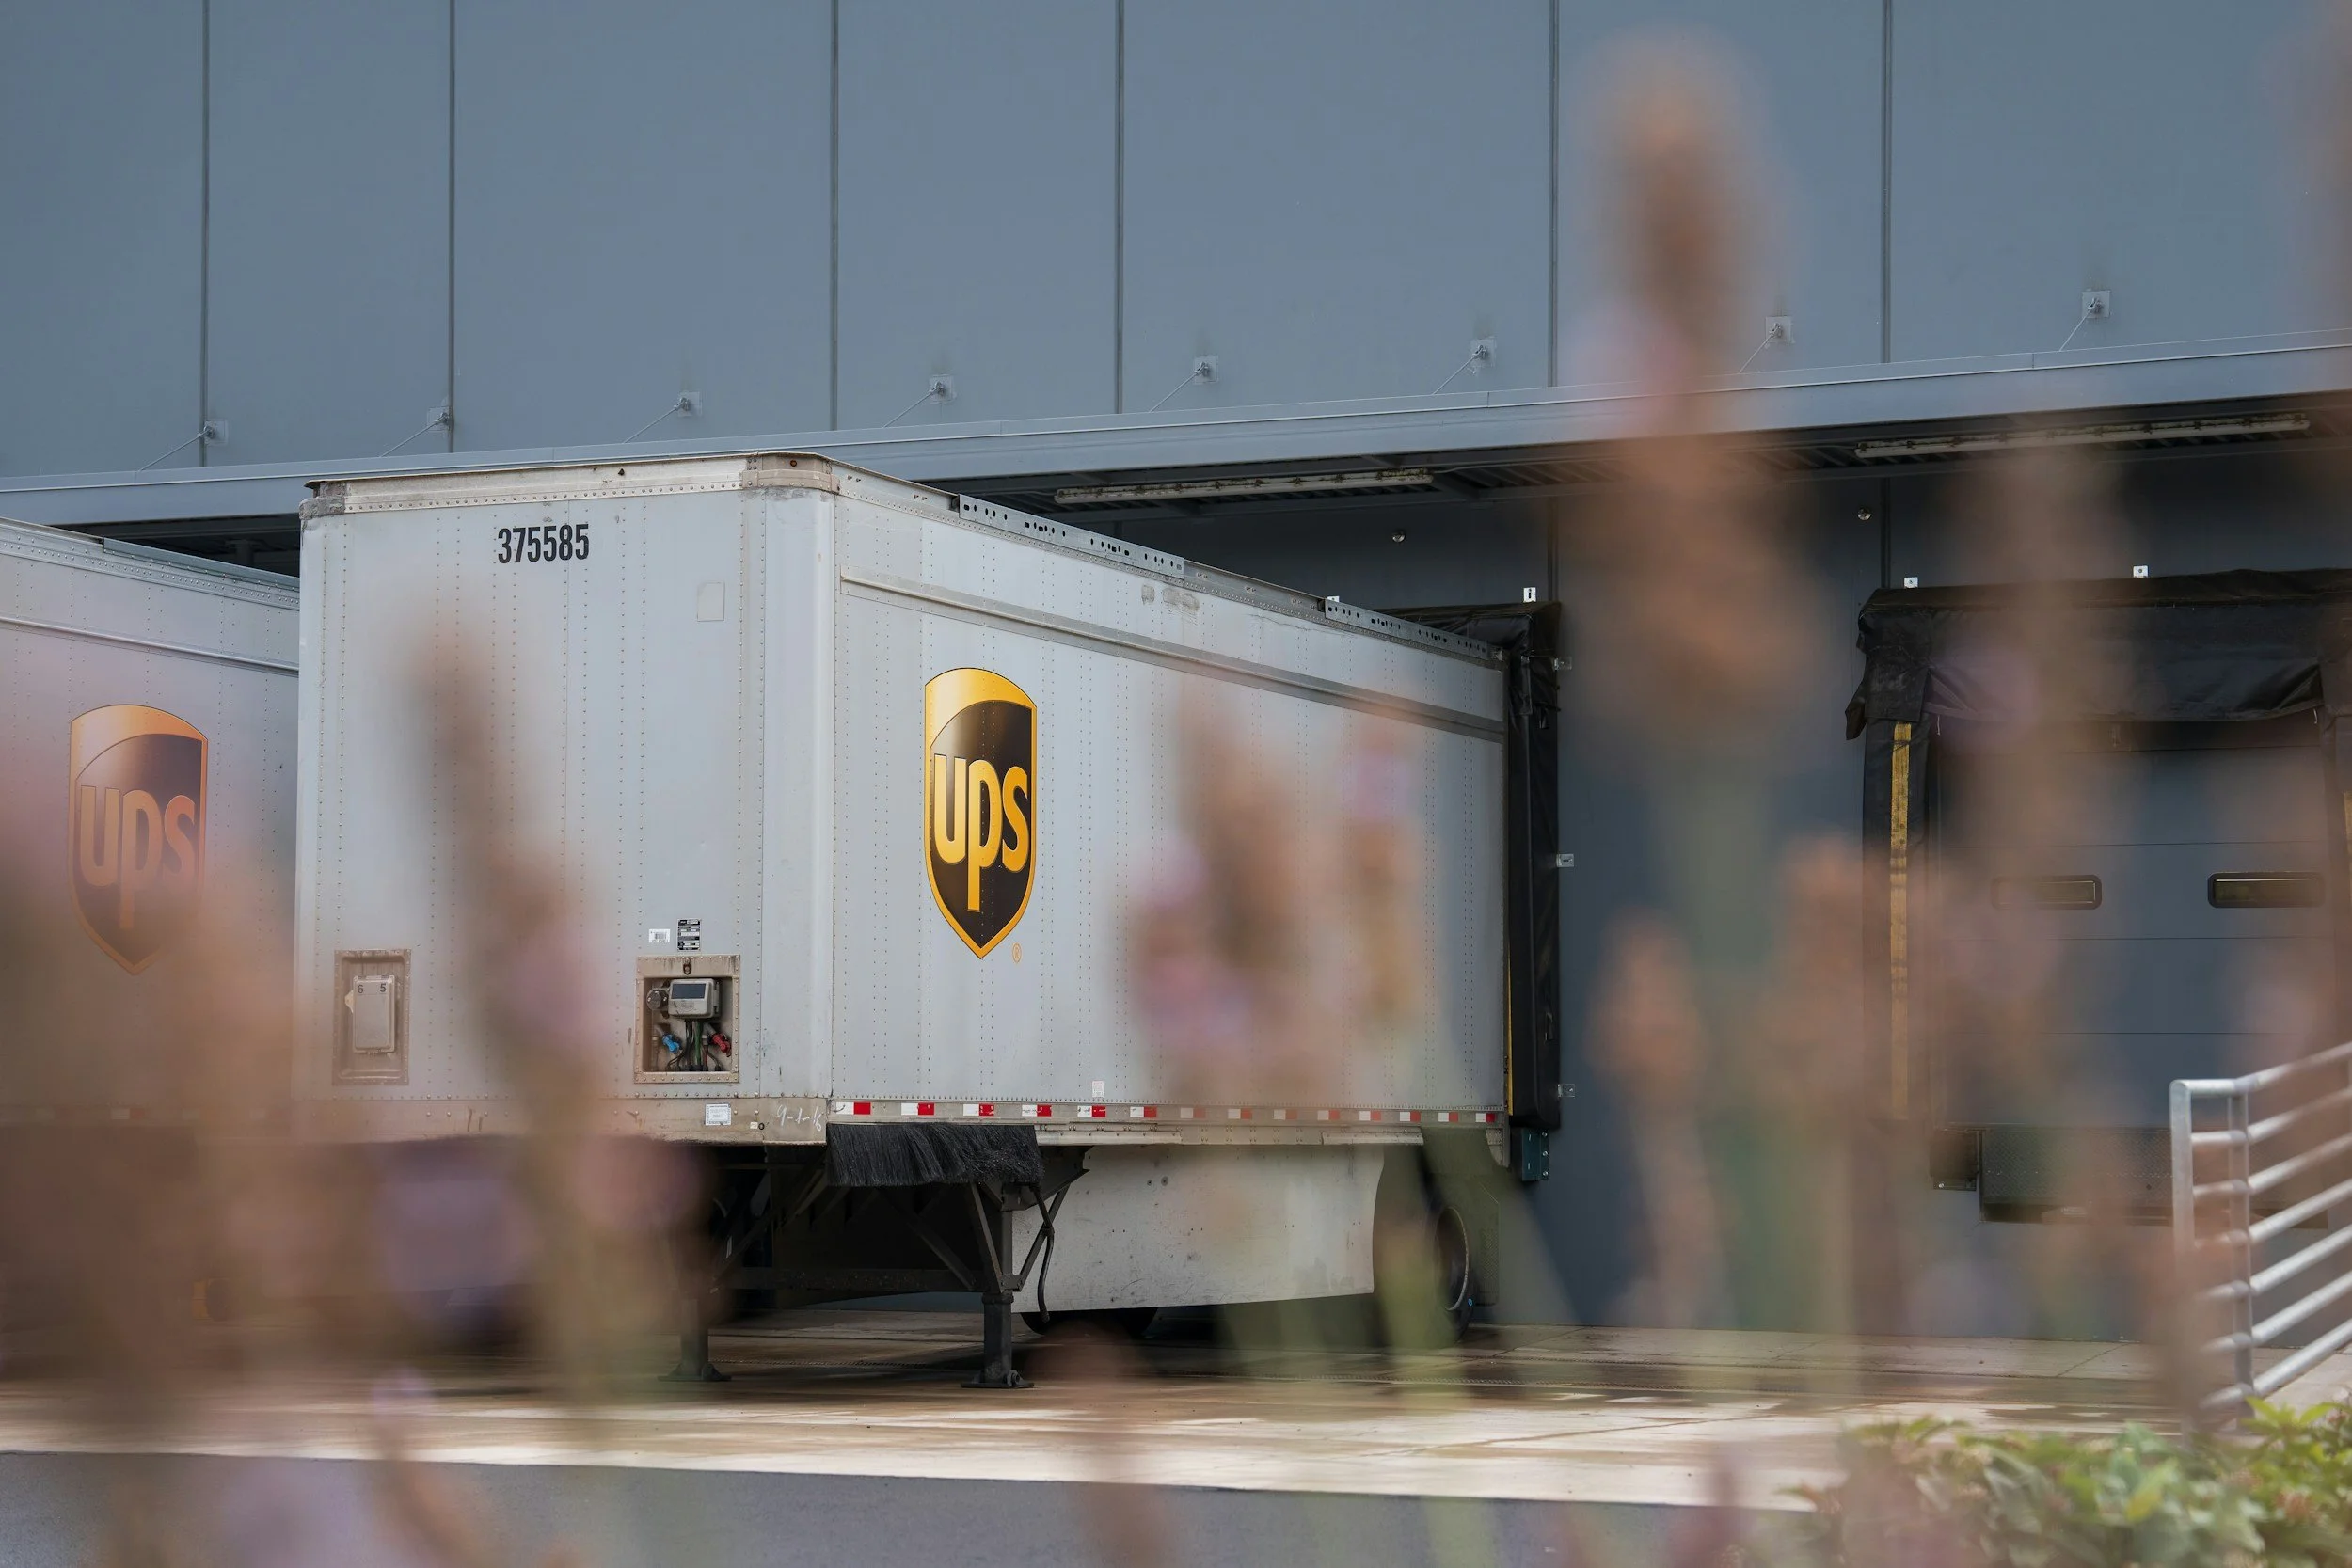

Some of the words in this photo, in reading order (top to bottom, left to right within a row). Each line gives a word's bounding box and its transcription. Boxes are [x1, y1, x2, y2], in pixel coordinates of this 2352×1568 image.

[498, 523, 590, 564] 375585
[80, 784, 196, 929] ups
[933, 753, 1030, 912] ups
[357, 984, 364, 994] 6
[379, 983, 387, 993] 5
